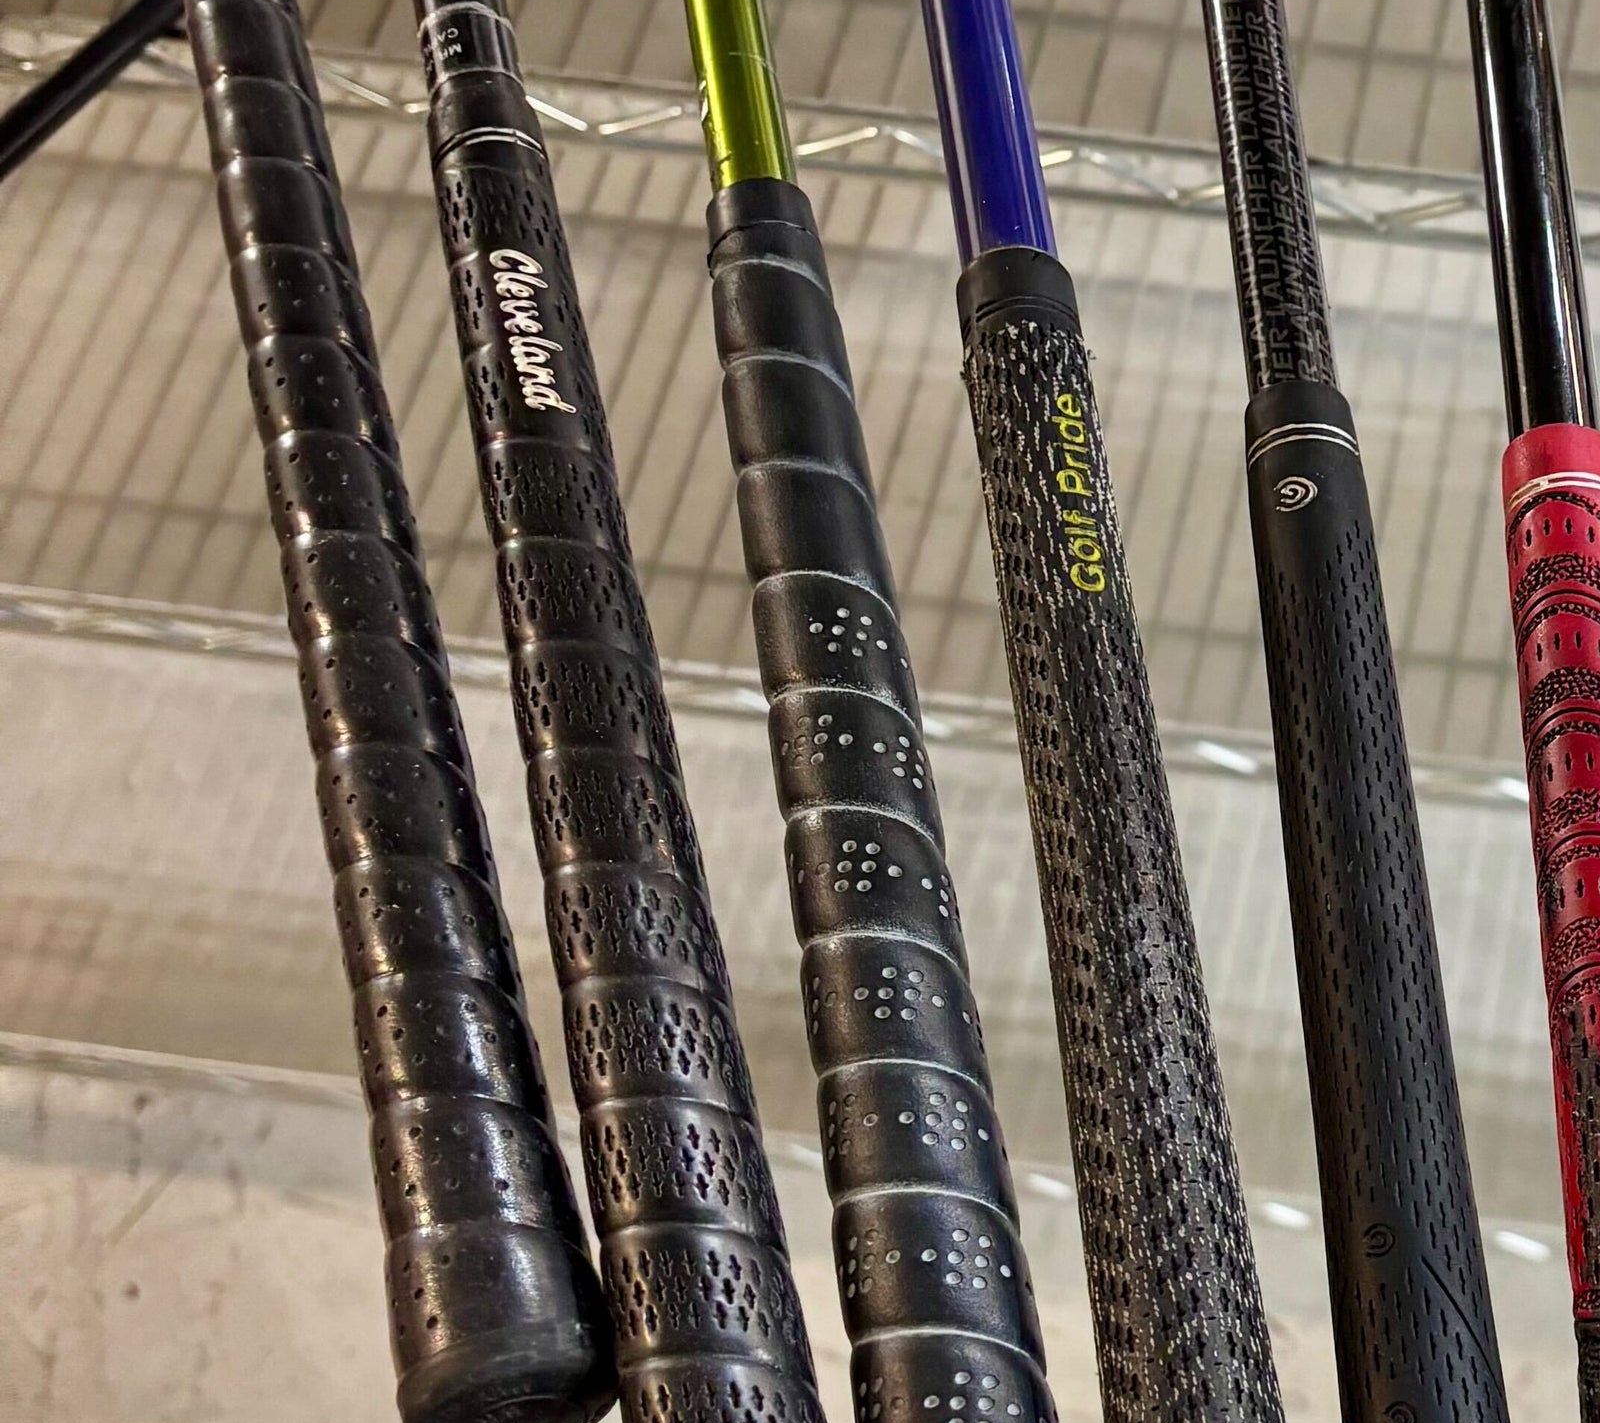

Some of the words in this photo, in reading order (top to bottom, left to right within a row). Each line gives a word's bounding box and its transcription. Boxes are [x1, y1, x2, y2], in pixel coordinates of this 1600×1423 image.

[489, 247, 577, 416] Cleveland
[1050, 392, 1095, 497] Pride
[1061, 509, 1107, 594] Golf
